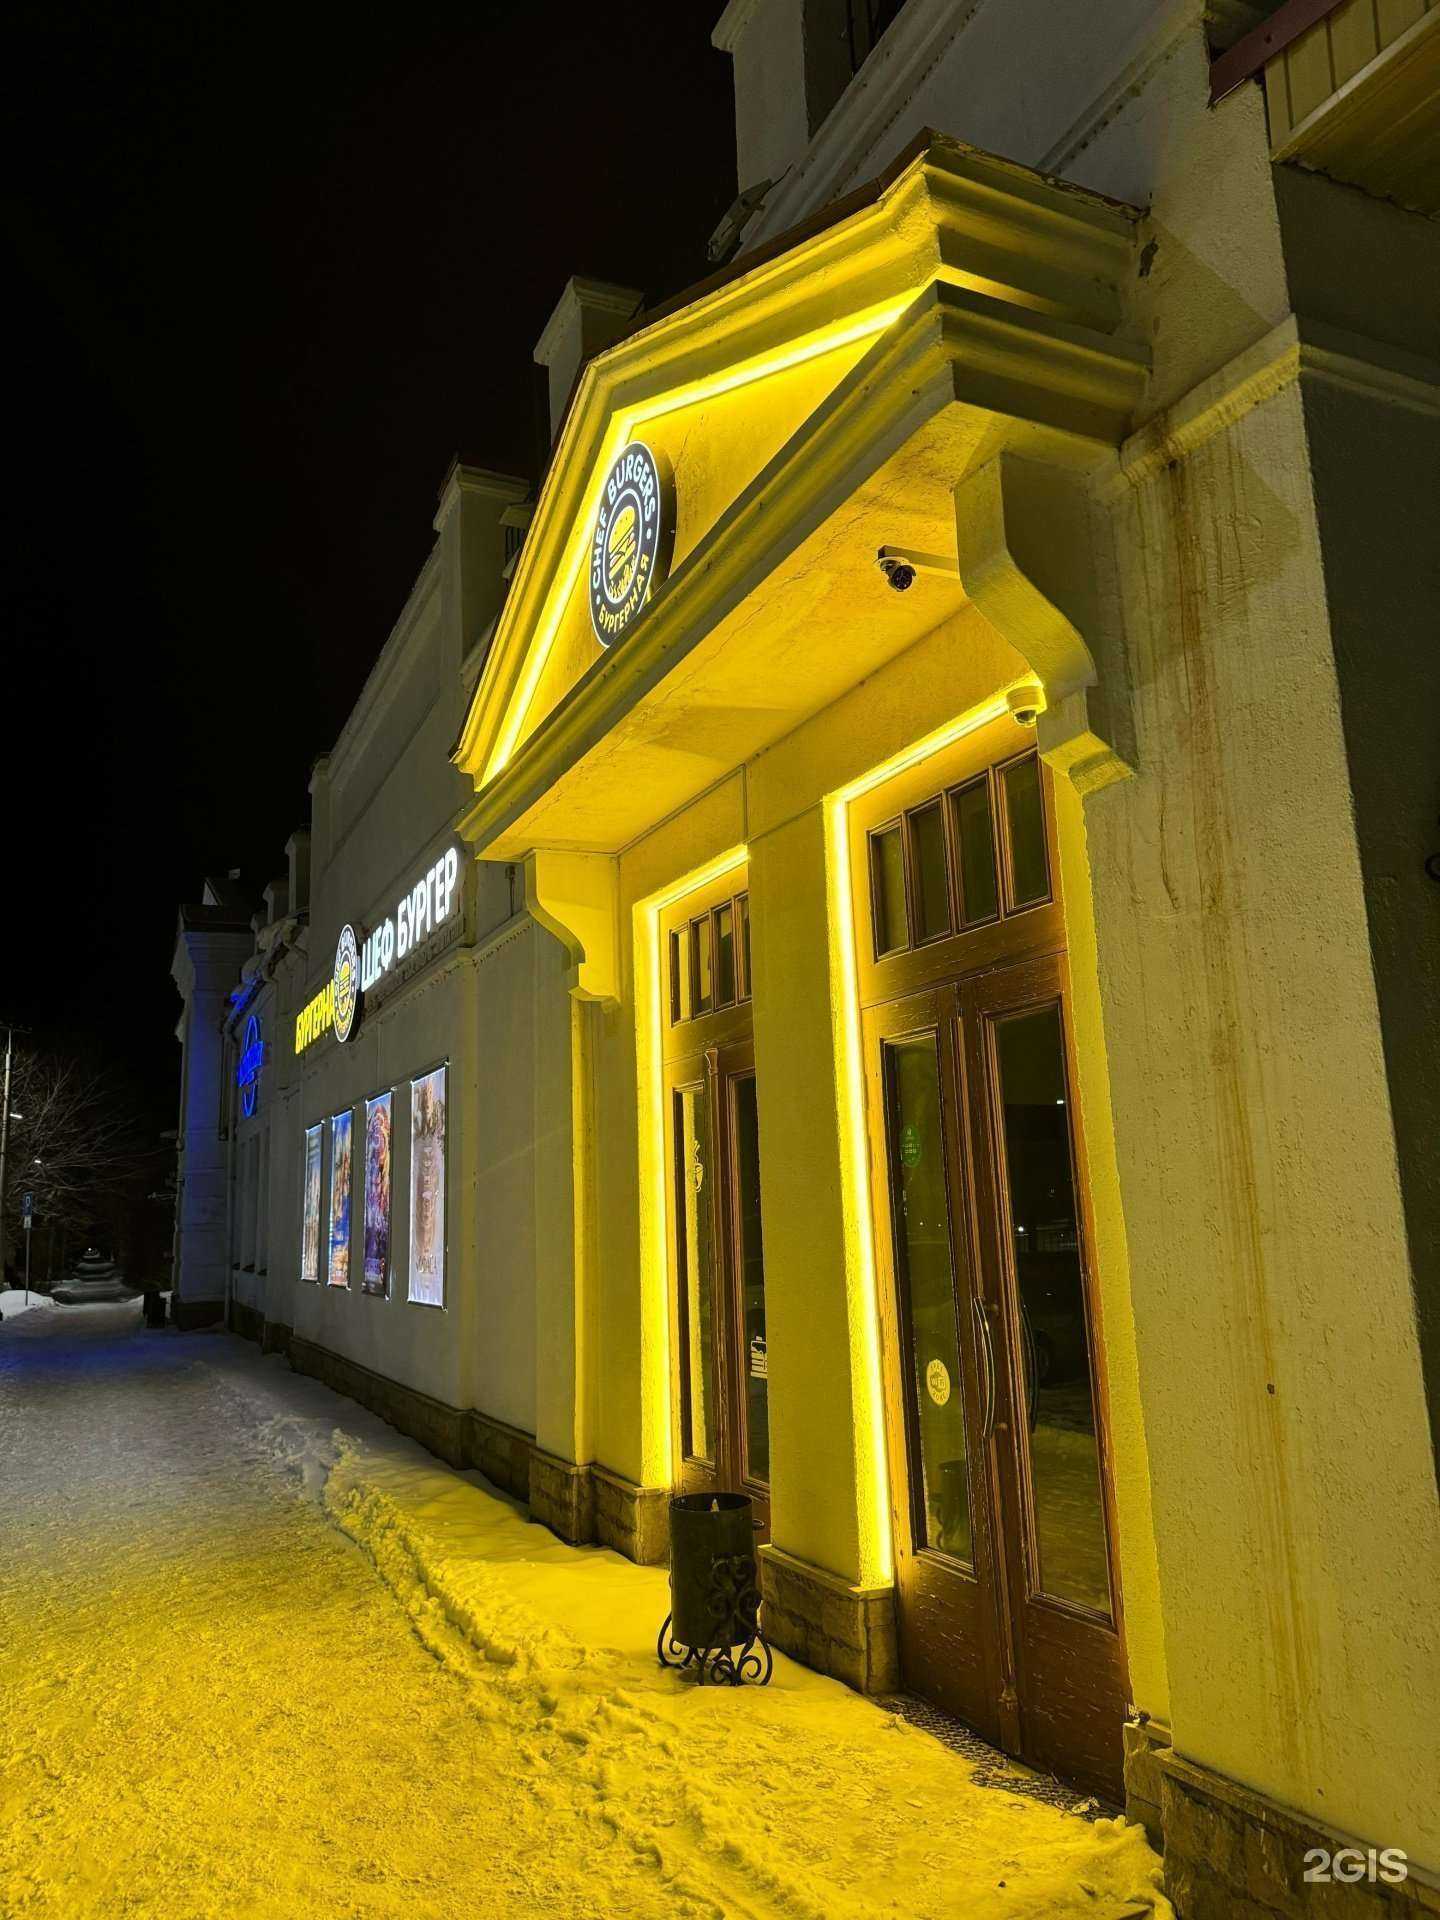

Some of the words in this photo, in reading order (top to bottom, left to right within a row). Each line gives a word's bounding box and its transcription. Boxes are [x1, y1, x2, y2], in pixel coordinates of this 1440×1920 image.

[592, 507, 607, 589] CHEF
[607, 454, 656, 522] BURGERS
[598, 553, 650, 634] БУРГЕРНАЯ
[295, 978, 335, 1055] БУРГЕРНА
[361, 917, 394, 992] ШЕФ
[397, 847, 458, 959] БУРГЕР
